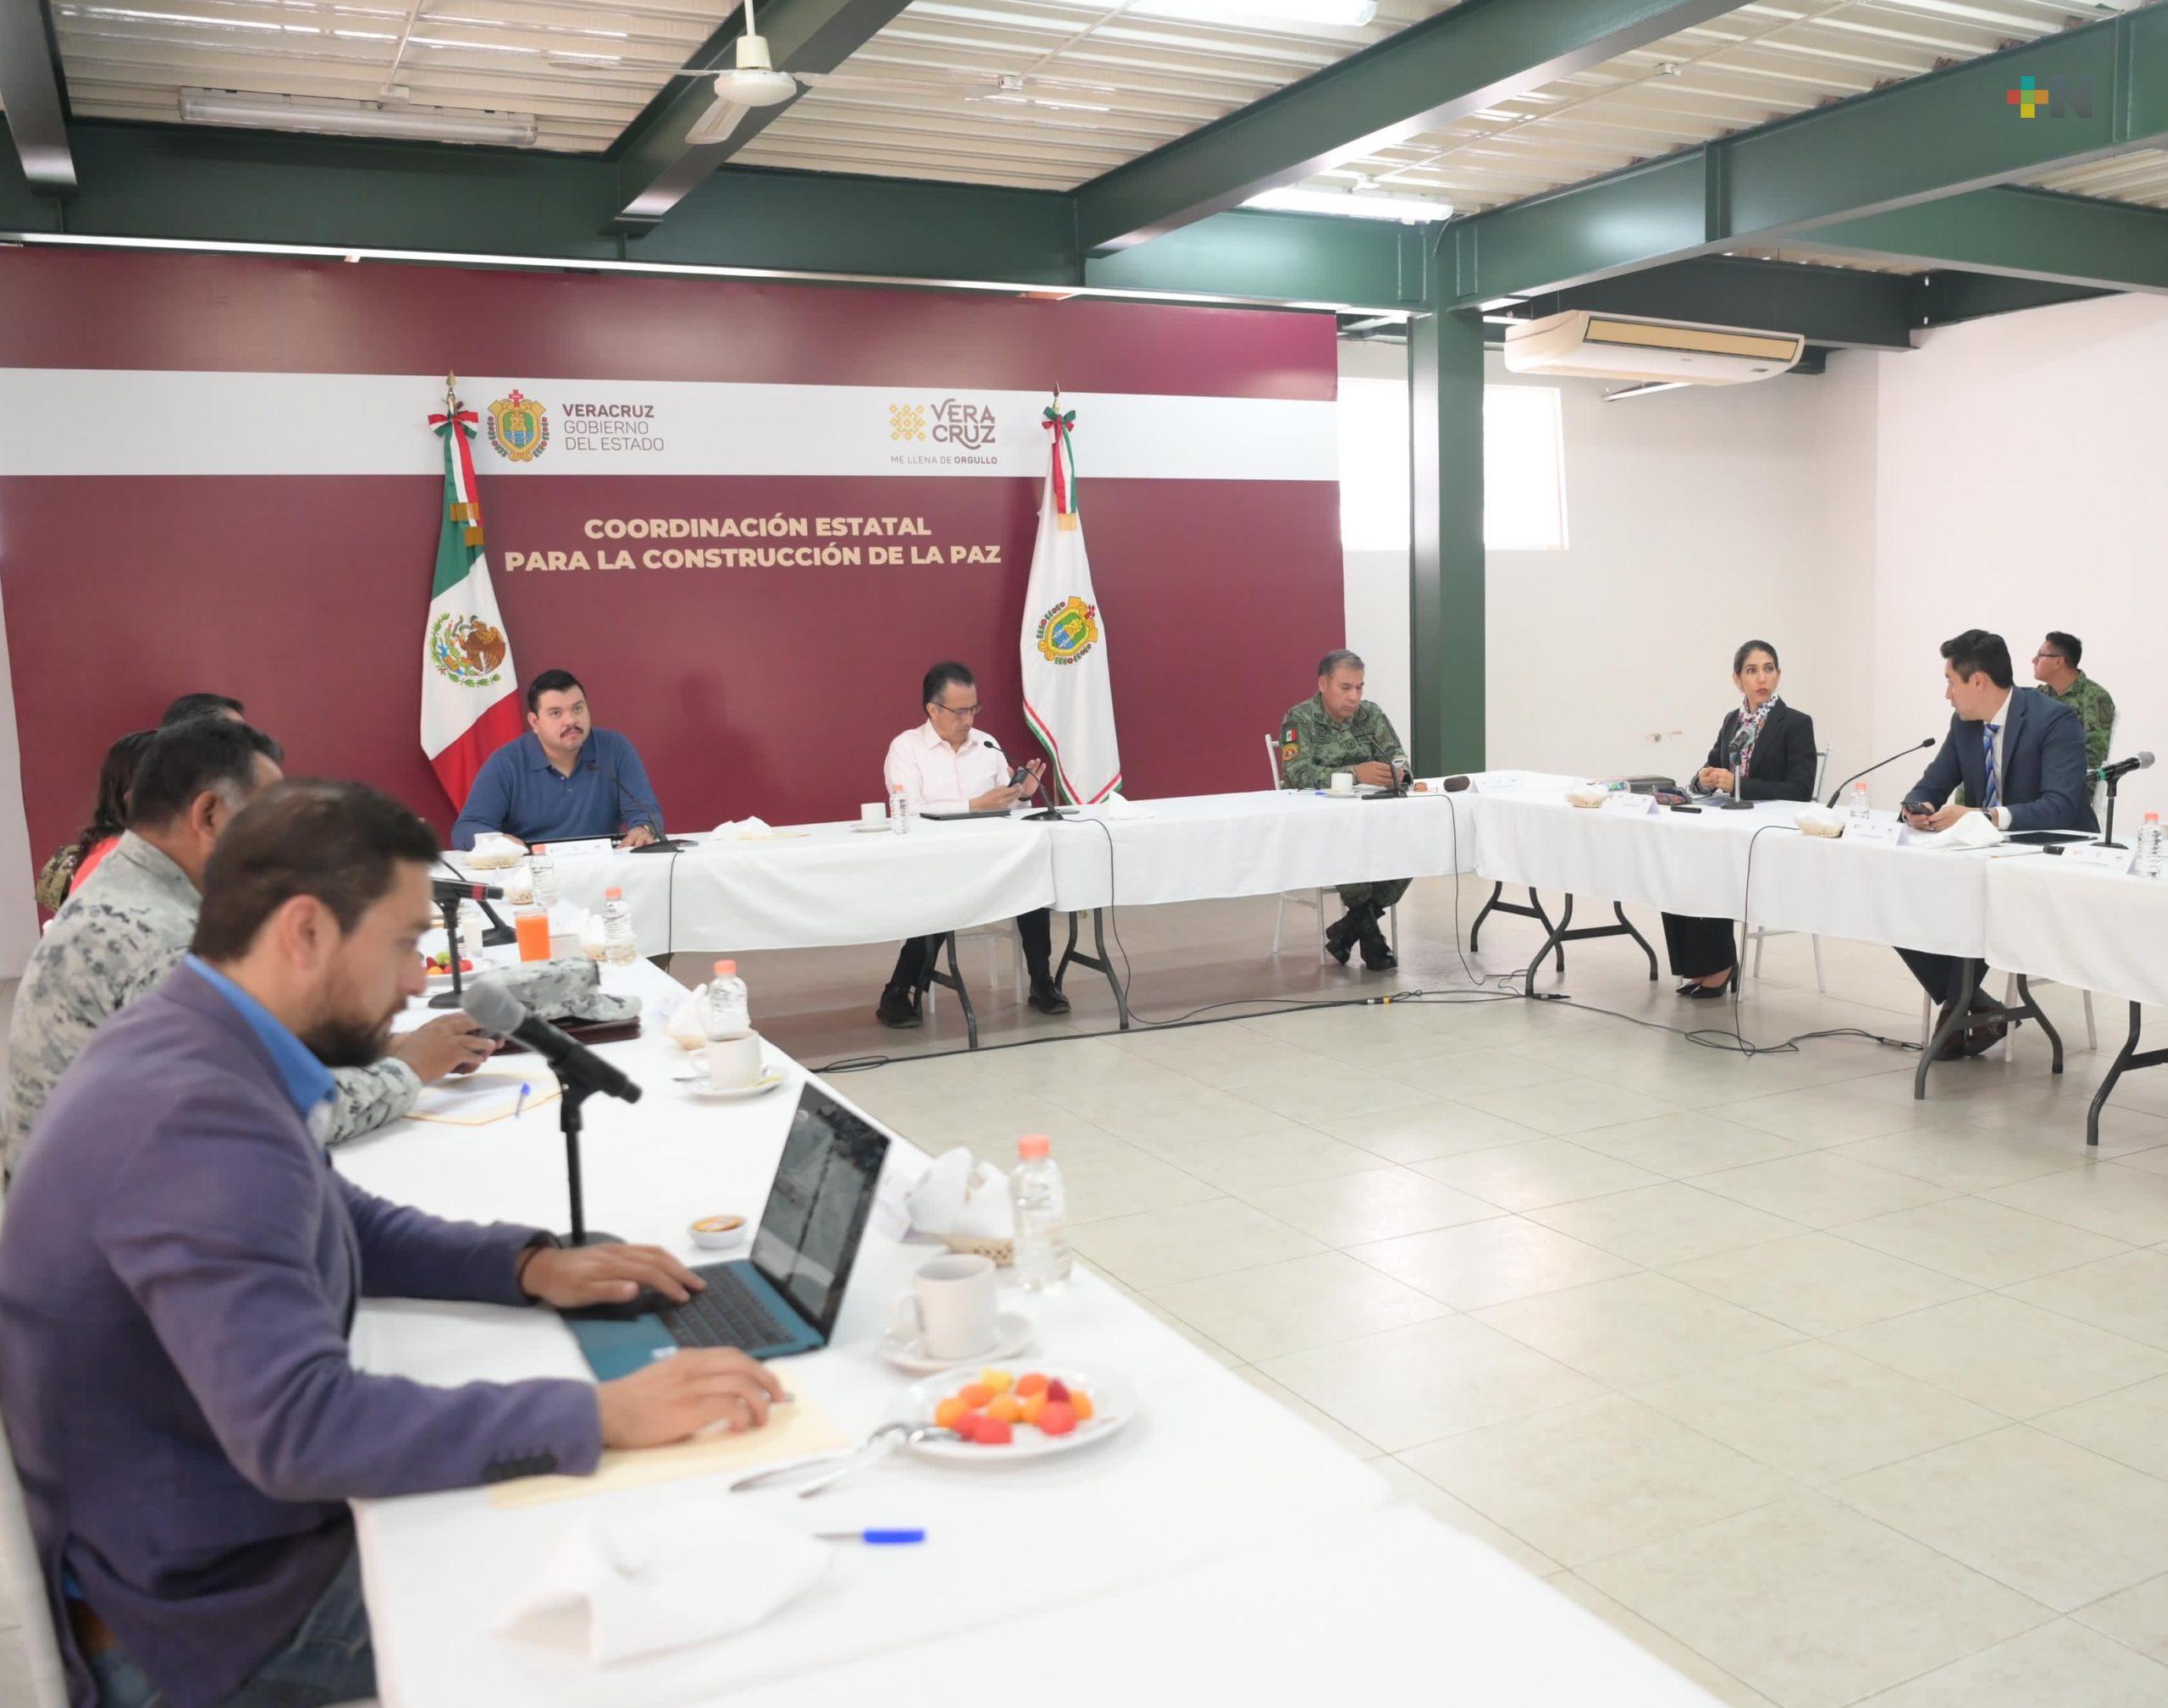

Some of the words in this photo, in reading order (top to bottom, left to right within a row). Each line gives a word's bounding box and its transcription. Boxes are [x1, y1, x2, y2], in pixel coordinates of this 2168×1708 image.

[562, 404, 655, 418] VERACRUZ
[931, 398, 996, 423] VERA
[564, 420, 649, 434] GOBIERNO
[566, 437, 597, 450] DEL
[600, 437, 665, 451] ESTADO
[932, 424, 996, 450] CRUZ
[891, 456, 905, 464] ME
[907, 456, 937, 464] LLENA
[940, 456, 951, 464] DE
[954, 456, 998, 465] ORGULLO
[583, 512, 808, 539] COORDINACIÓN
[816, 517, 932, 536] ESTATAL
[505, 550, 591, 572] PARA
[597, 550, 637, 570] LA
[642, 542, 861, 569] CONSTRUCCIÓN
[868, 546, 904, 565] DE
[910, 545, 944, 565] LA
[950, 545, 1002, 564] PAZ
